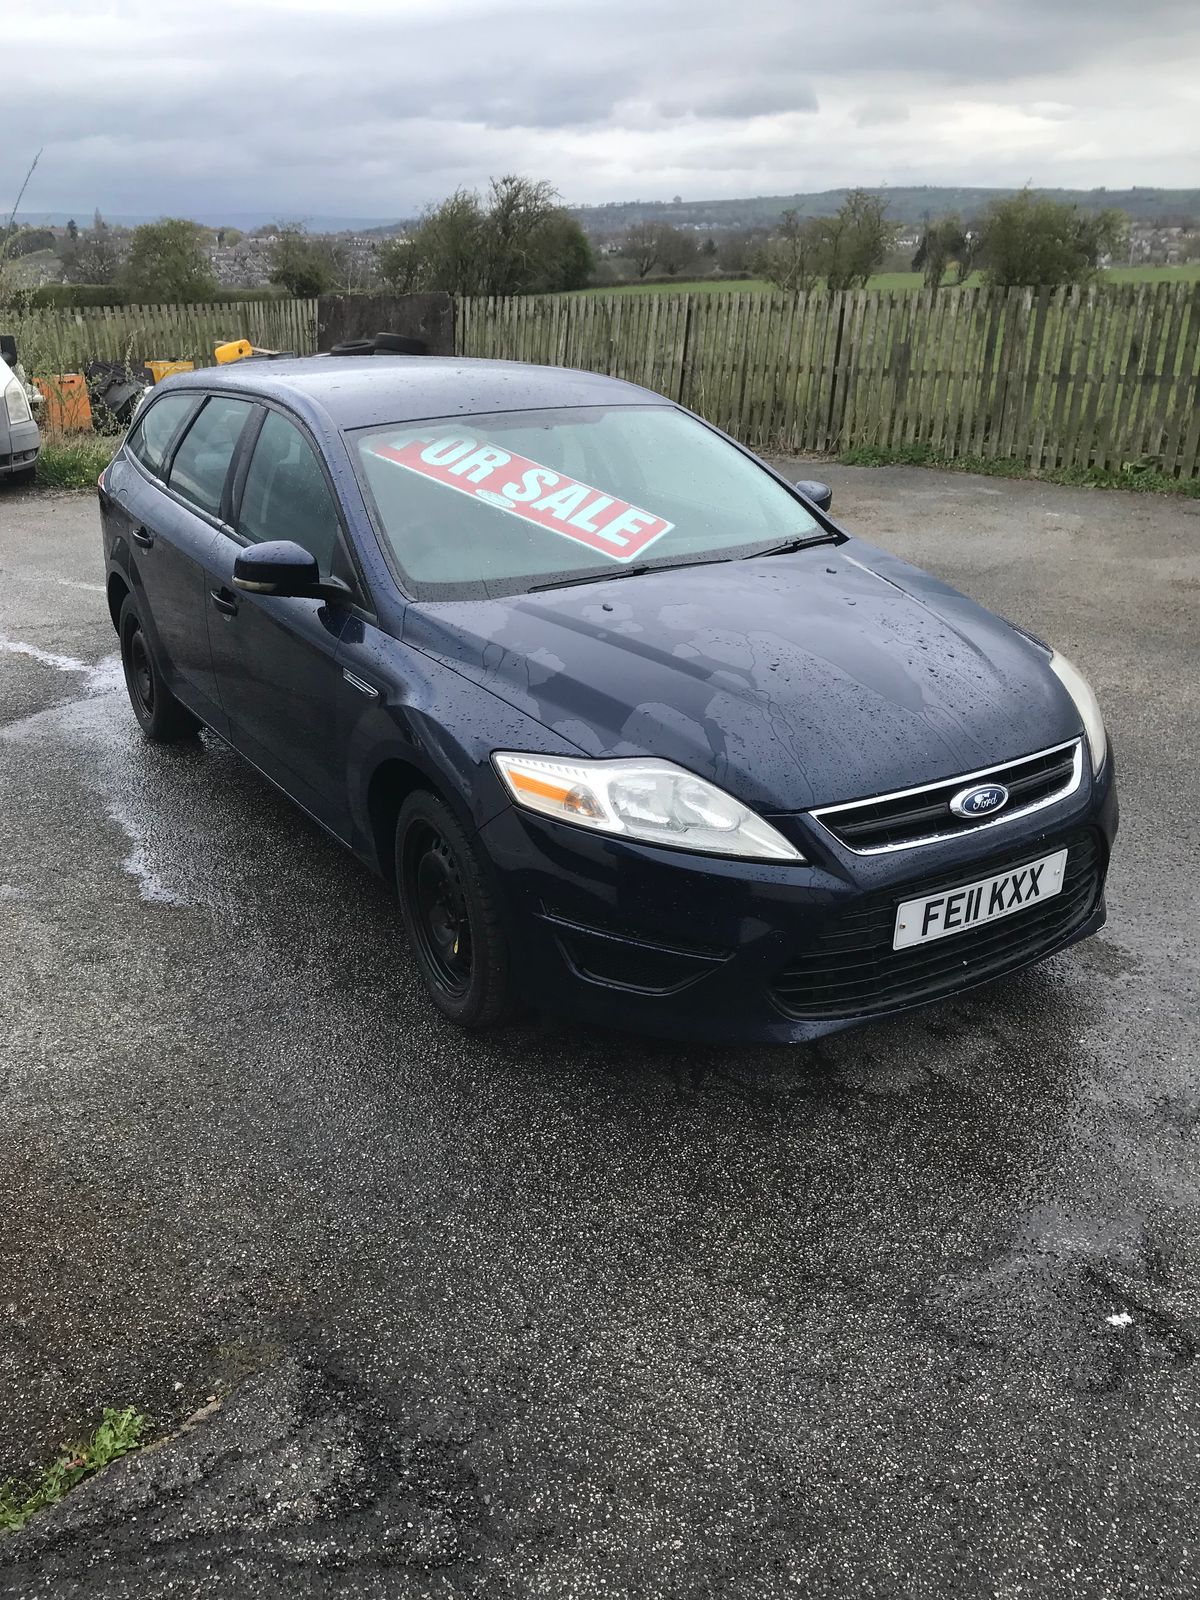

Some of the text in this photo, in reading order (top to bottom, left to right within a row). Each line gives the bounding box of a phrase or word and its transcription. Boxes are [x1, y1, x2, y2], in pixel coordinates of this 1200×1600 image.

[502, 468, 655, 547] SALE
[973, 791, 998, 810] Ford
[921, 863, 1044, 936] FE11 KXX
